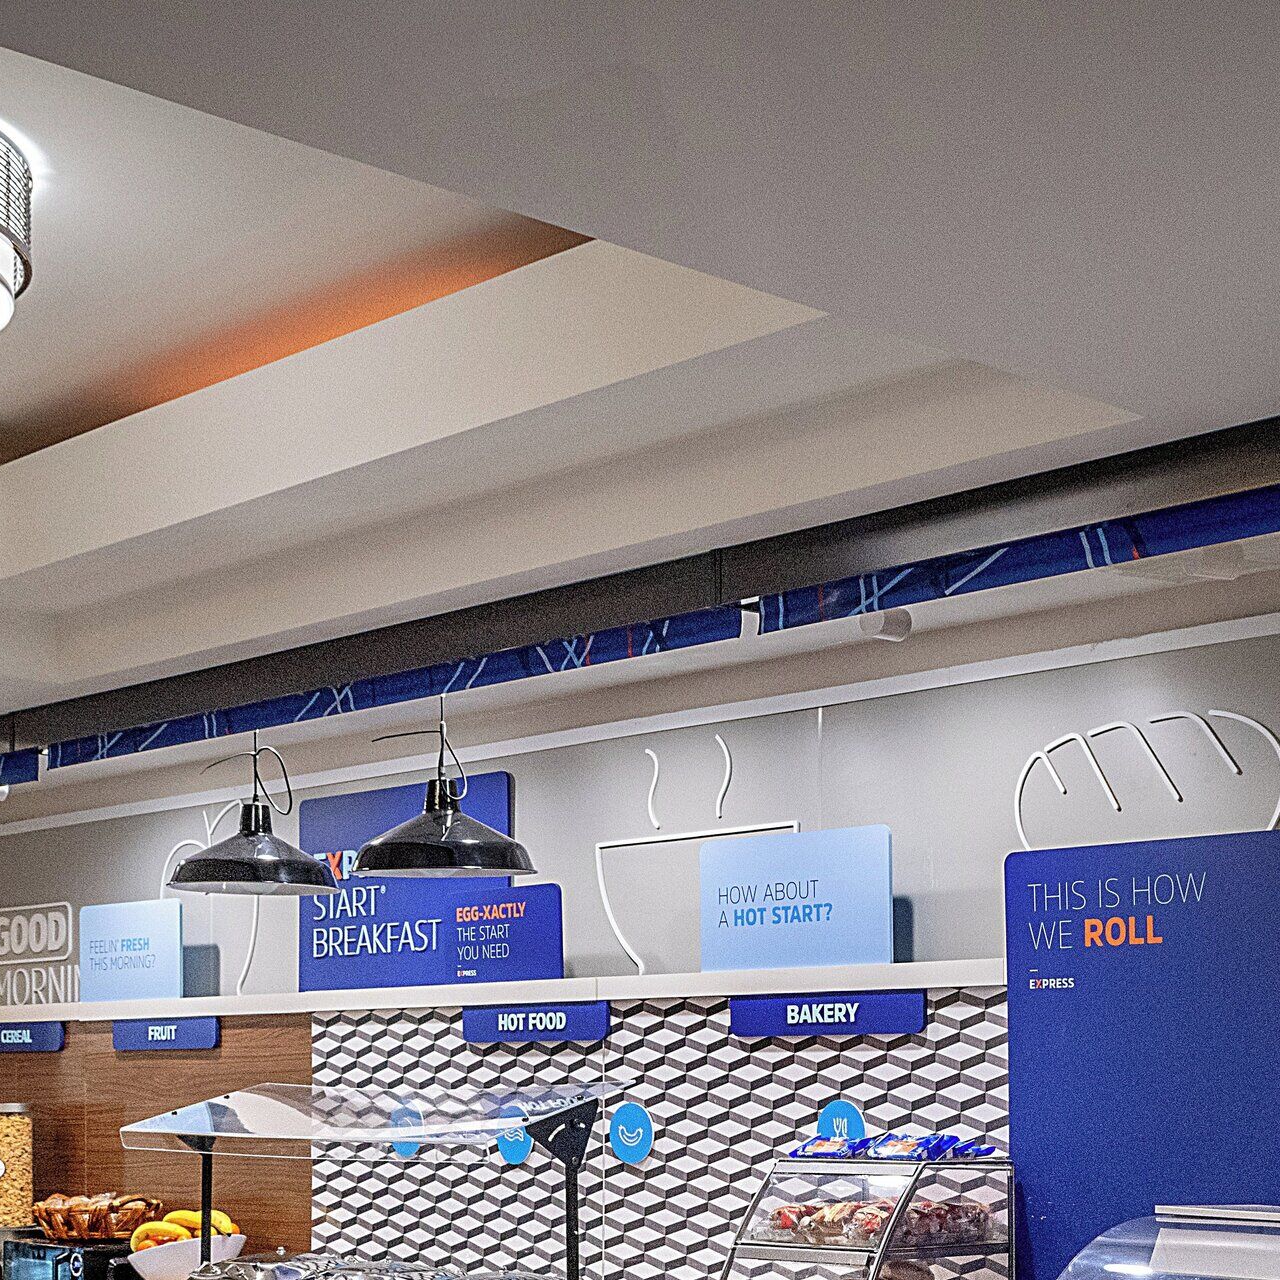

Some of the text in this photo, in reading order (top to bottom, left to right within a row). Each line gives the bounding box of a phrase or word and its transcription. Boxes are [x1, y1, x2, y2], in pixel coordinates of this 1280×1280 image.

[718, 879, 819, 905] HOW ABOUT
[1027, 871, 1207, 912] THIS IS HOW
[456, 901, 527, 923] EGG-XACTLY
[718, 902, 833, 928] A HOT START?
[312, 919, 442, 958] BREAKFAST
[457, 923, 510, 942] THE START
[1028, 915, 1164, 950] WE ROLL
[121, 937, 150, 952] FRESH
[457, 943, 510, 961] YOU NEED
[89, 953, 156, 971] THIS MORNING?
[1029, 977, 1075, 990] EXPRESS
[497, 1011, 567, 1032] HOT FOOD
[786, 1002, 860, 1025] BAKERY
[0, 1030, 33, 1044] CEREAL
[148, 1025, 178, 1041] FRUIT
